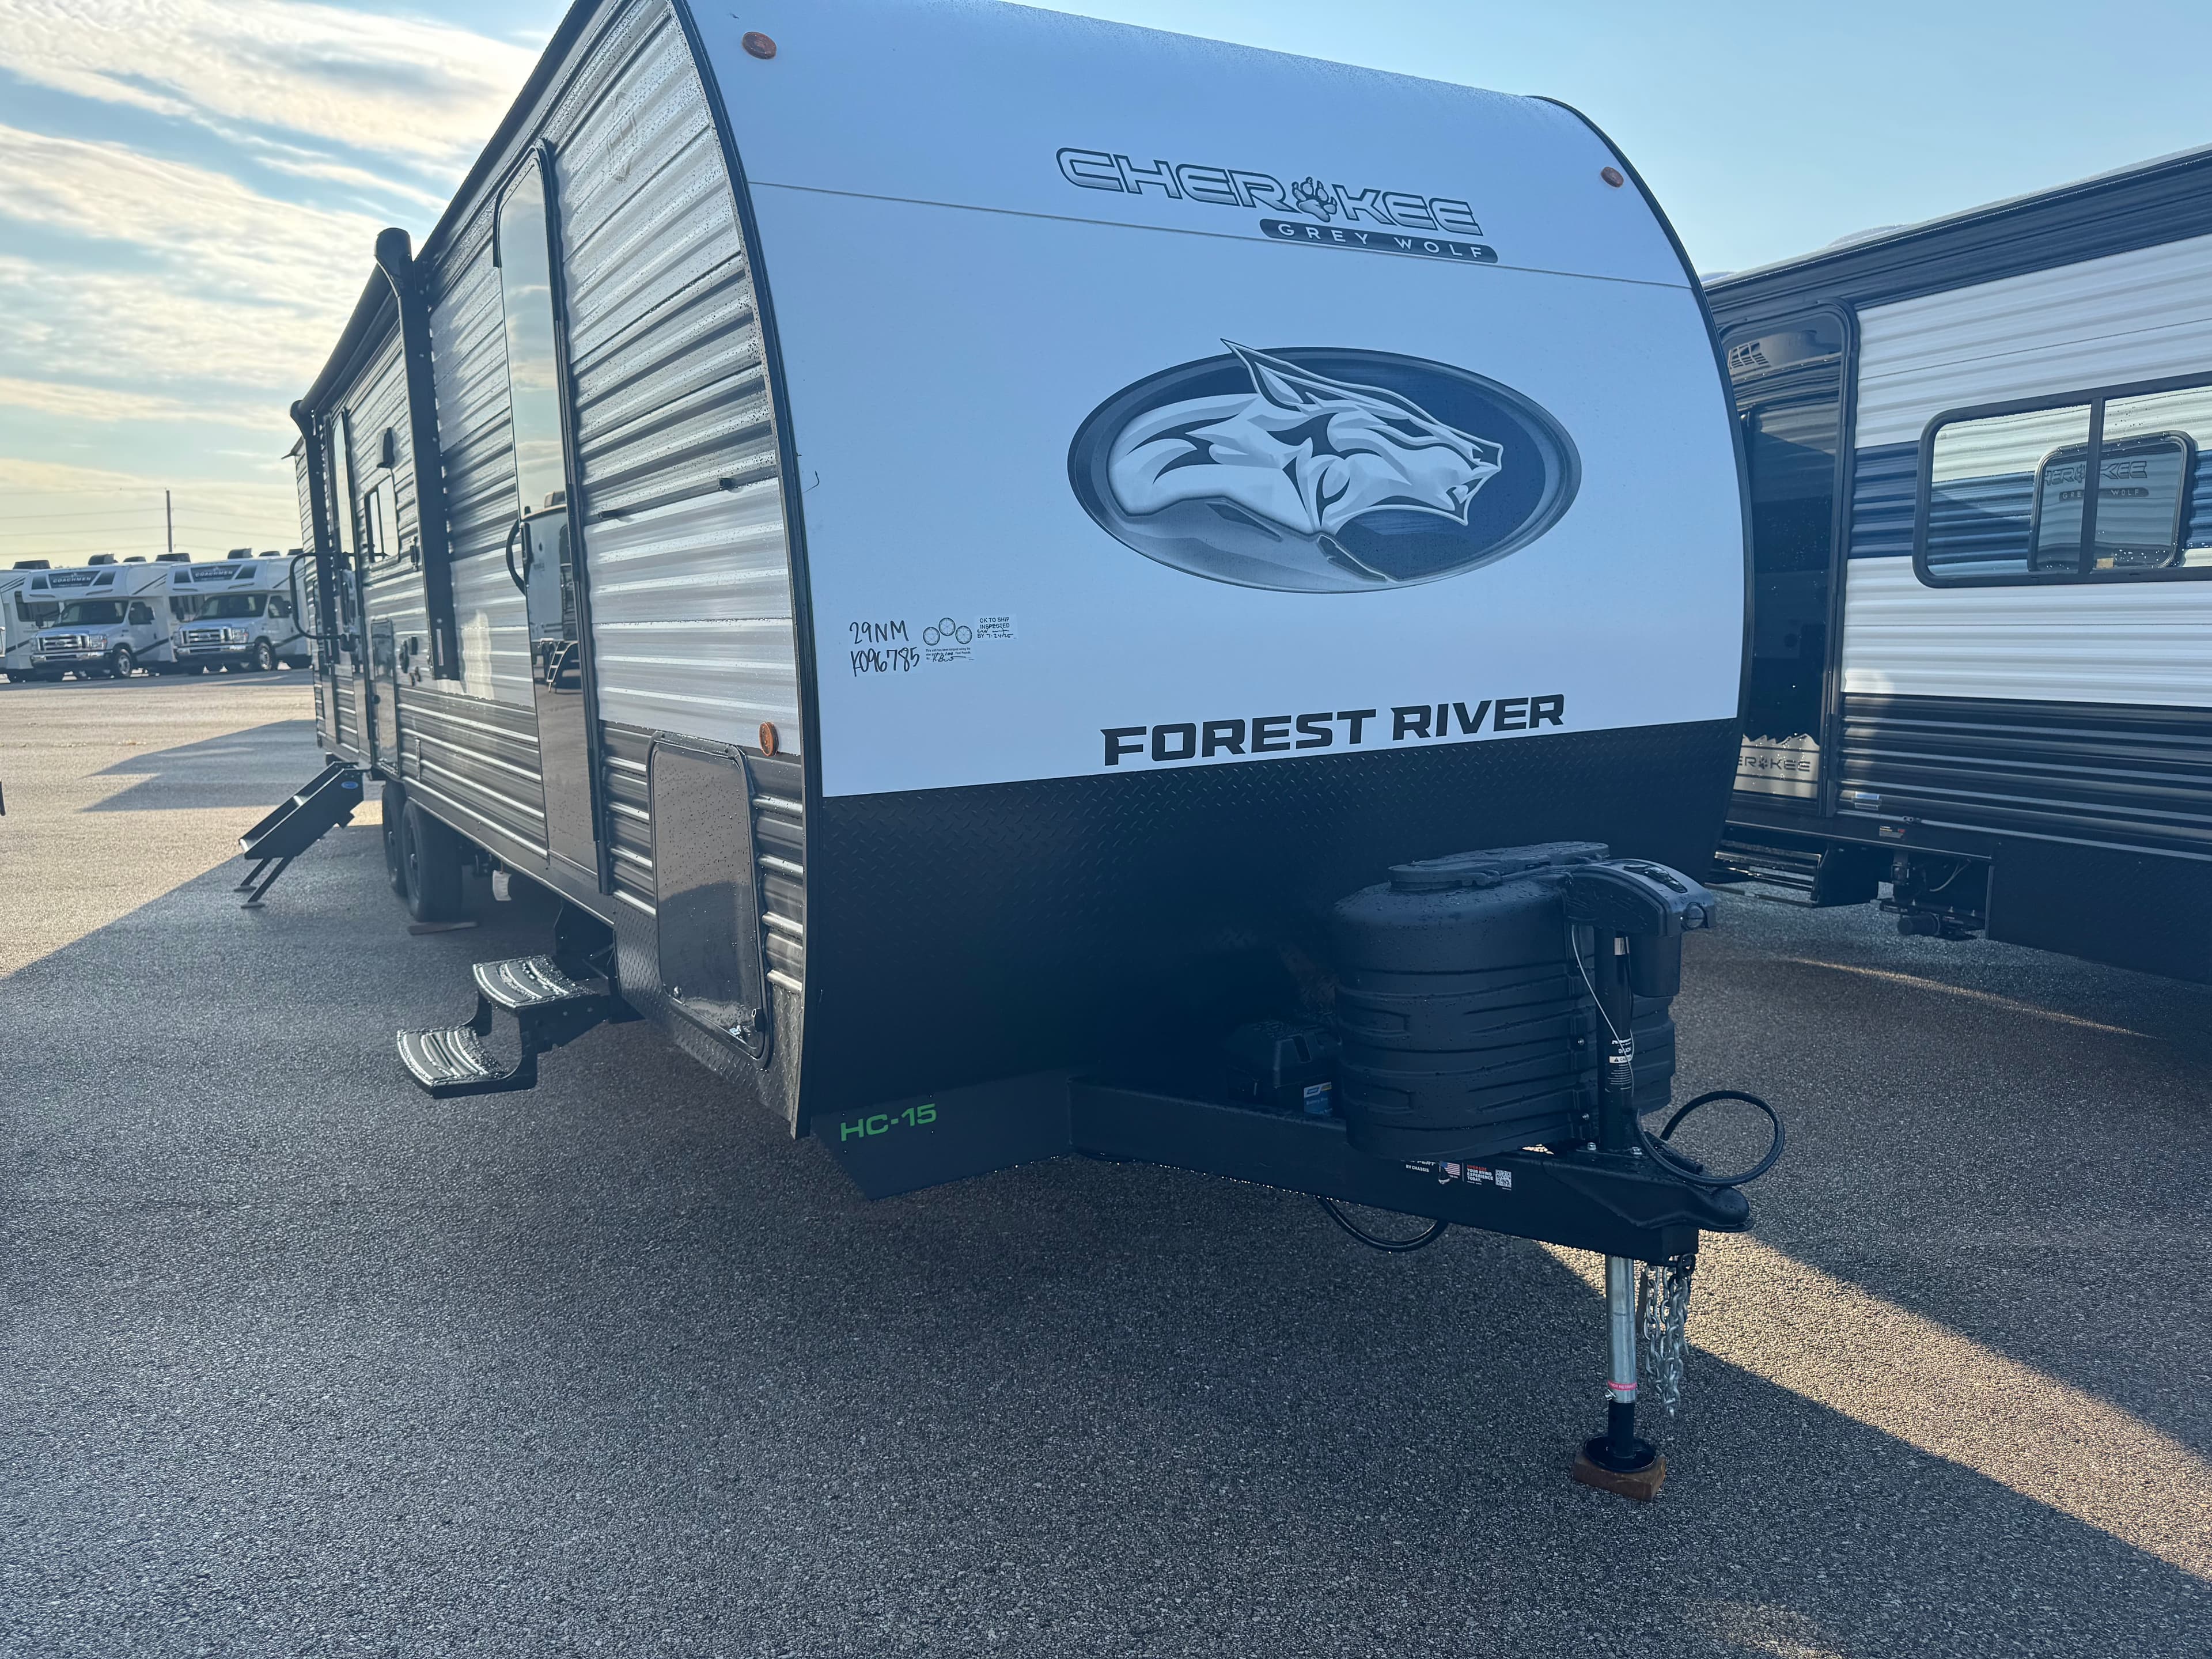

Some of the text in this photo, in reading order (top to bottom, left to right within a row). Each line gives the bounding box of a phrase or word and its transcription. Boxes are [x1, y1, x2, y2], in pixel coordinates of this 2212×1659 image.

[1277, 223, 1483, 259] GREY WOLF
[2062, 491, 2082, 499] GRE
[849, 620, 909, 644] 29NM
[1100, 694, 1565, 766] FOREST RIVER
[840, 1103, 937, 1142] HC-15
[1467, 1172, 1494, 1181] EXPERIENCE
